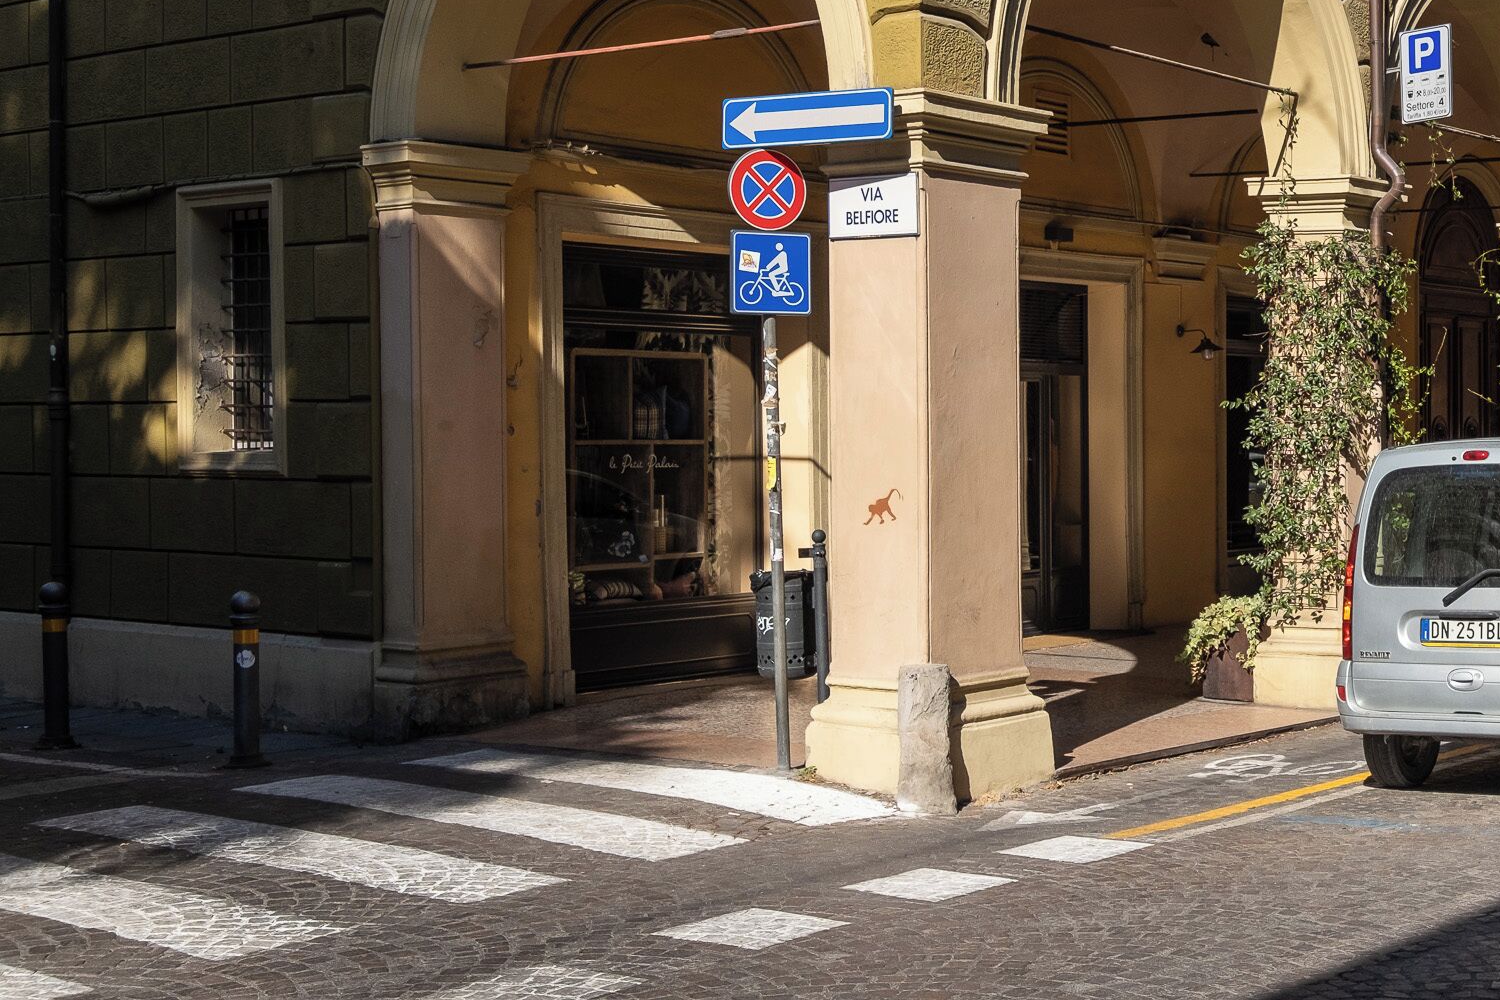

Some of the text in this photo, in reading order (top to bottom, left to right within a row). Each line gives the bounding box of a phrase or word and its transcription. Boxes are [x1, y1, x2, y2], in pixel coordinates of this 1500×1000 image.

[1415, 36, 1435, 69] P
[1406, 101, 1434, 112] Settore
[861, 187, 883, 201] VIA
[846, 209, 899, 225] BELFIORE
[621, 454, 643, 473] Petit
[646, 454, 679, 473] Palais
[1431, 622, 1449, 639] DN
